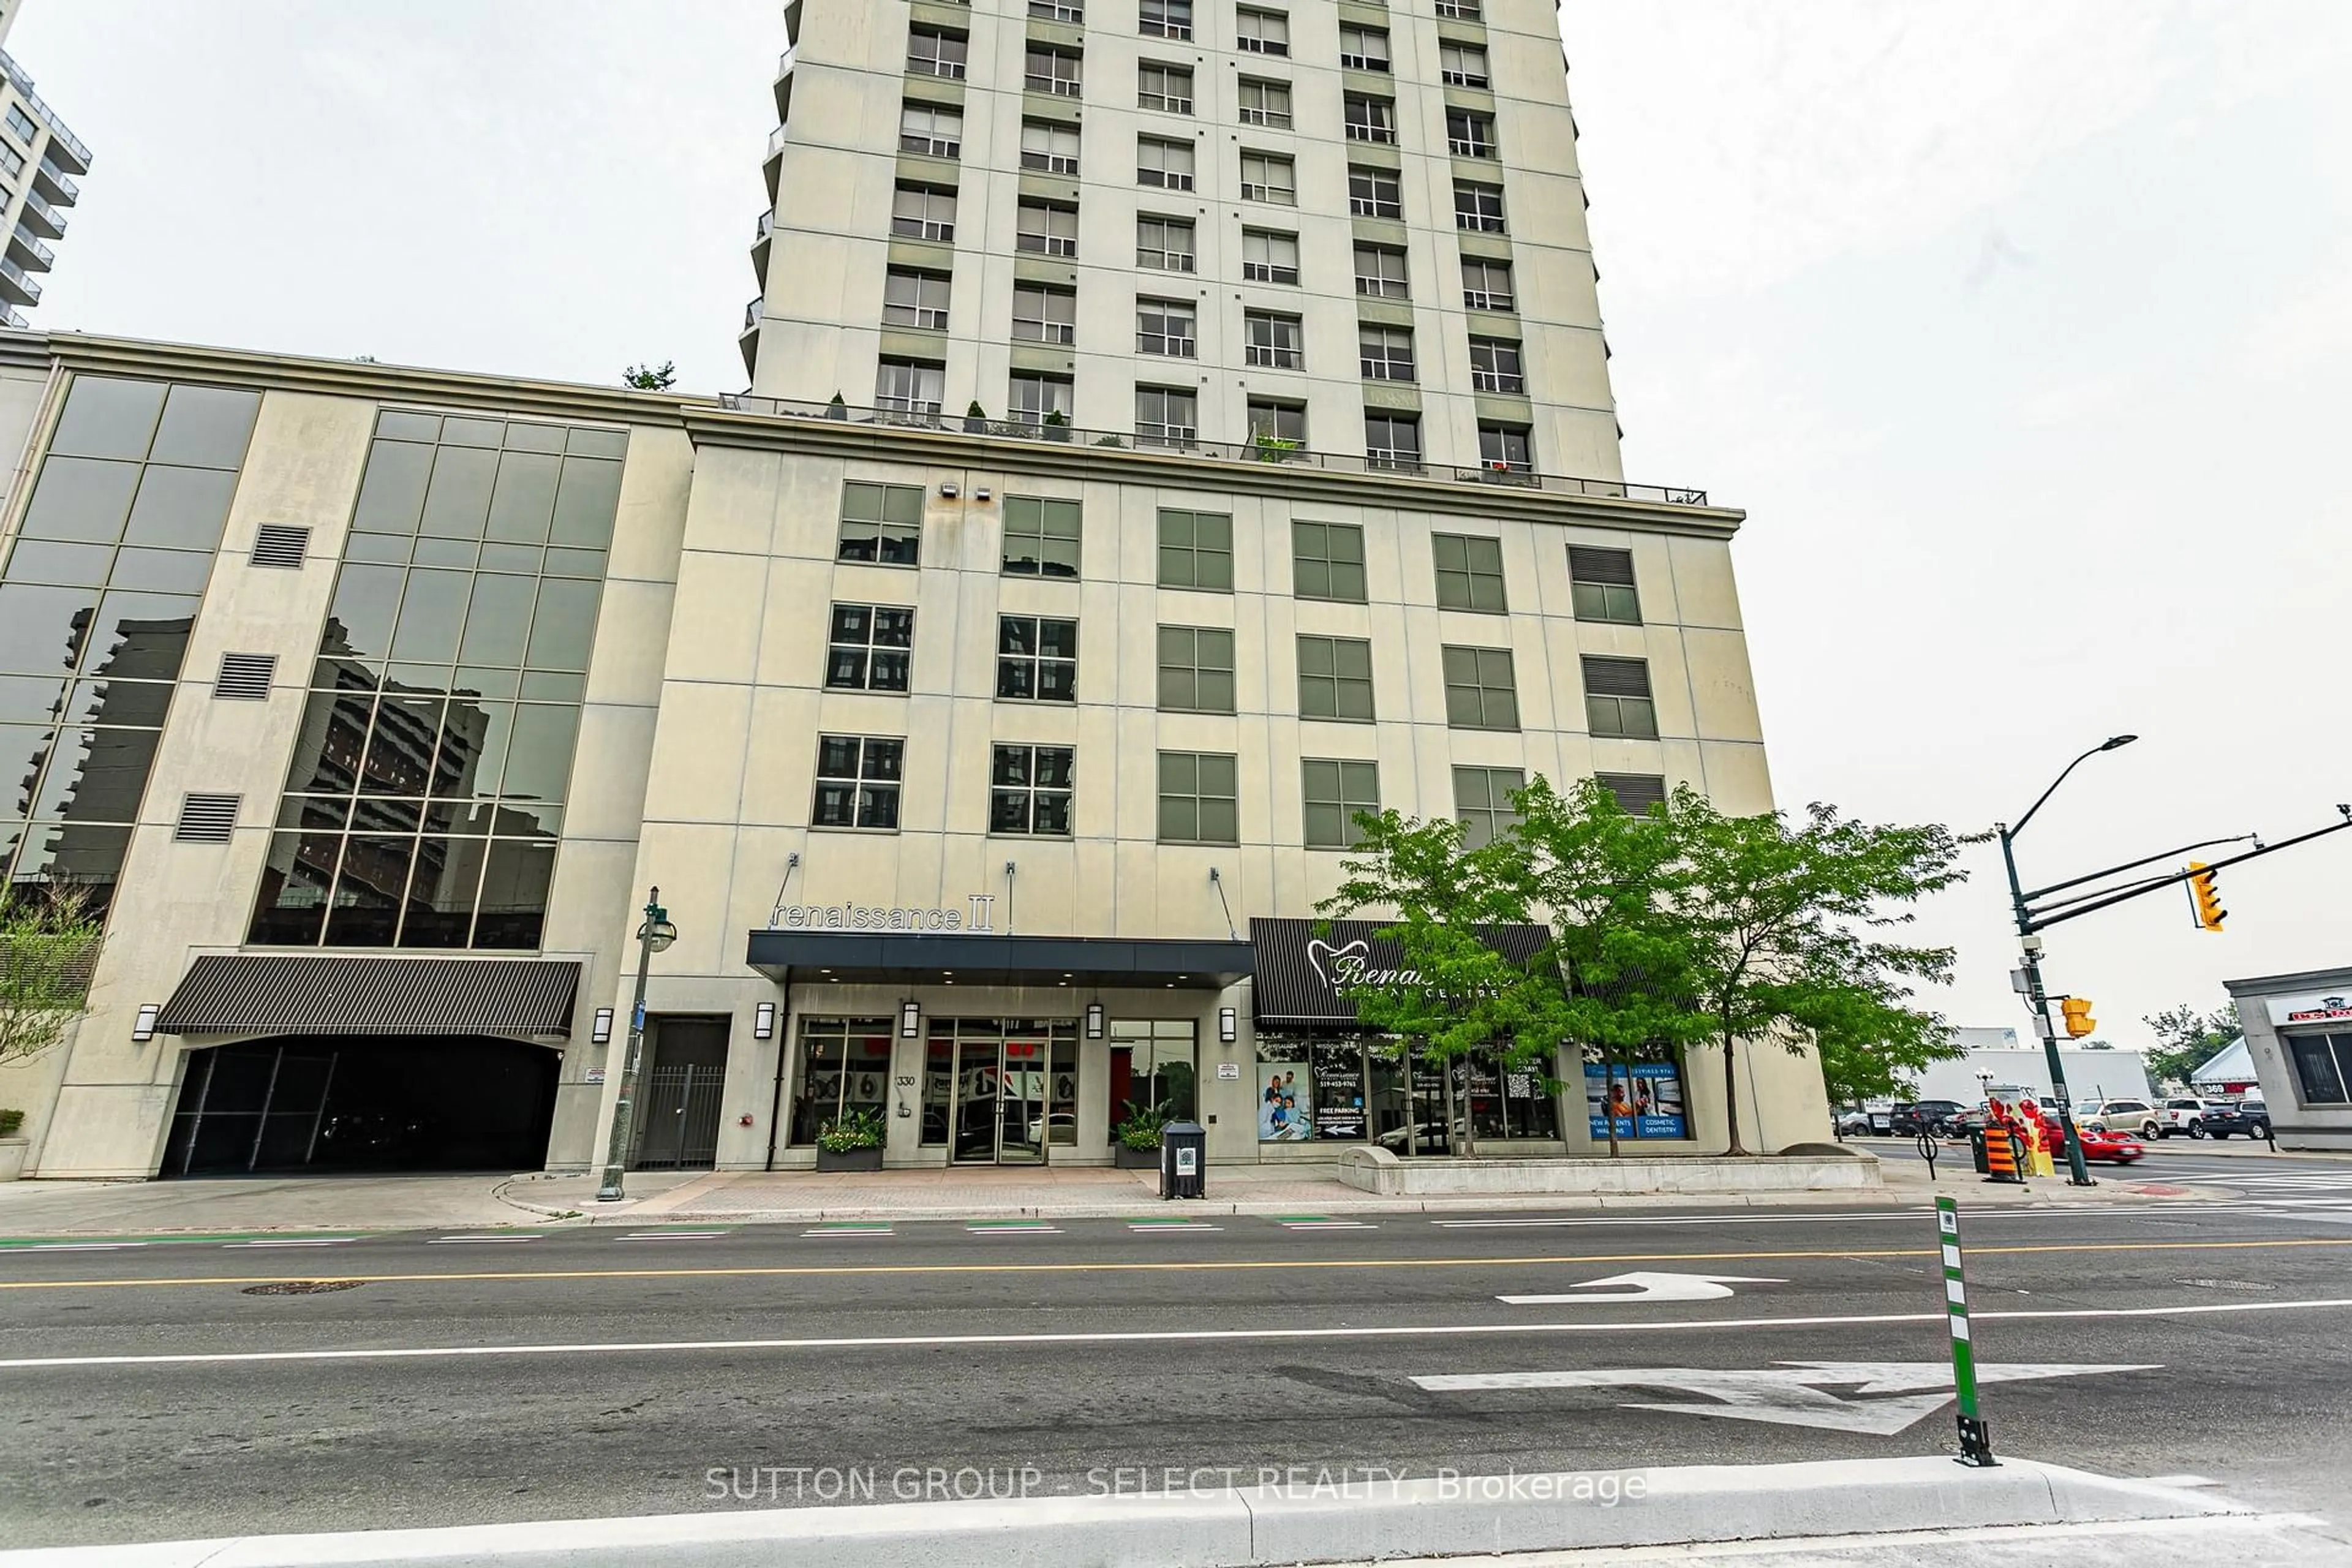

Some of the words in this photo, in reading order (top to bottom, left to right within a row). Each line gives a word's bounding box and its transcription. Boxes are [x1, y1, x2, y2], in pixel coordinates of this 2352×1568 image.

[774, 902, 962, 931] renaissance
[967, 894, 995, 932] II
[897, 1076, 915, 1086] 330
